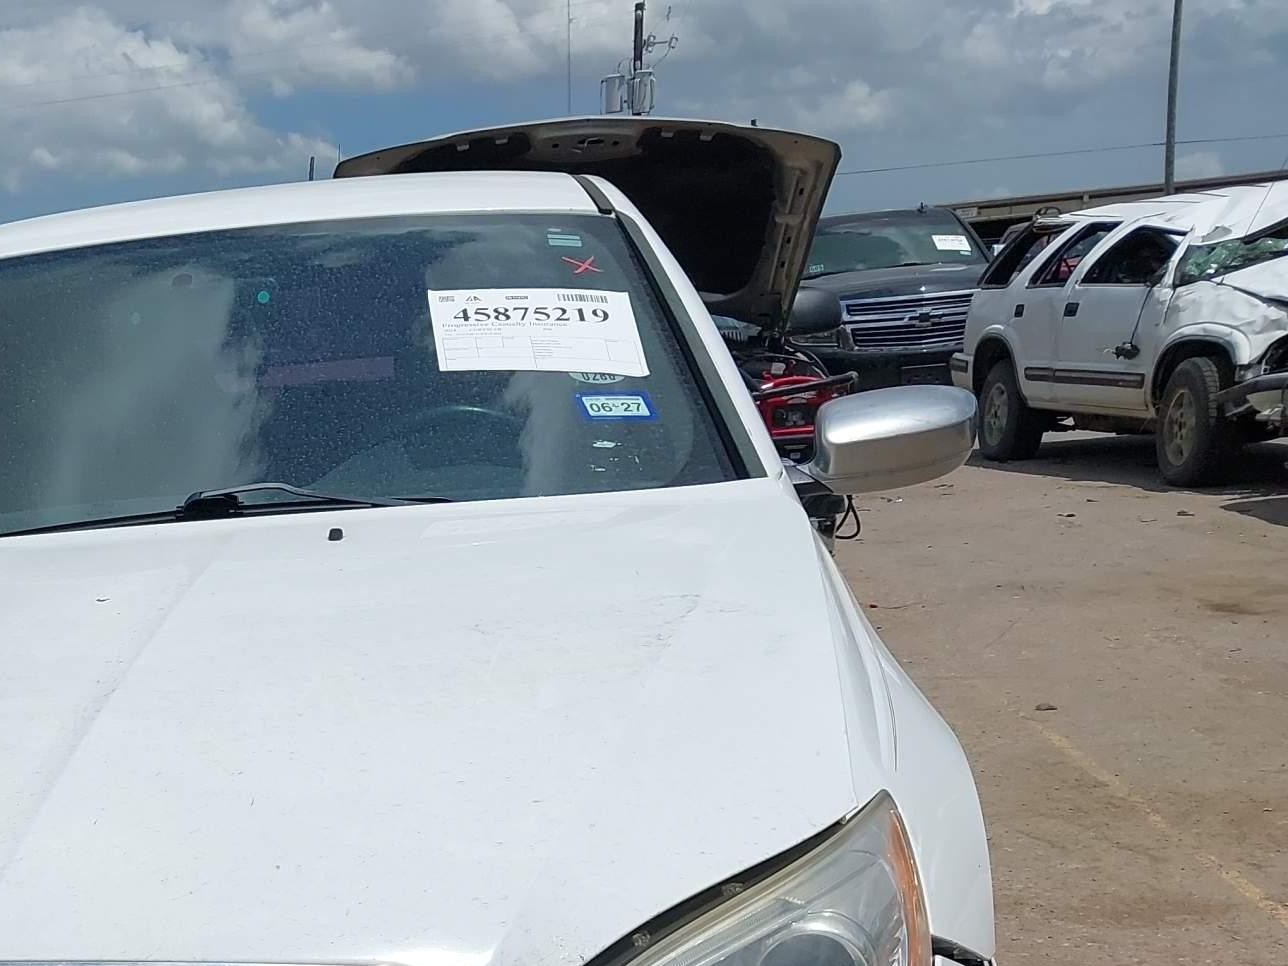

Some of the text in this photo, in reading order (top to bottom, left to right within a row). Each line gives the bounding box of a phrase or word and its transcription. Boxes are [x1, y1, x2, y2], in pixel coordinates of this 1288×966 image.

[453, 306, 609, 323] 45875219
[442, 321, 489, 329] Progressive
[589, 402, 613, 413] 06
[620, 402, 641, 413] 27
